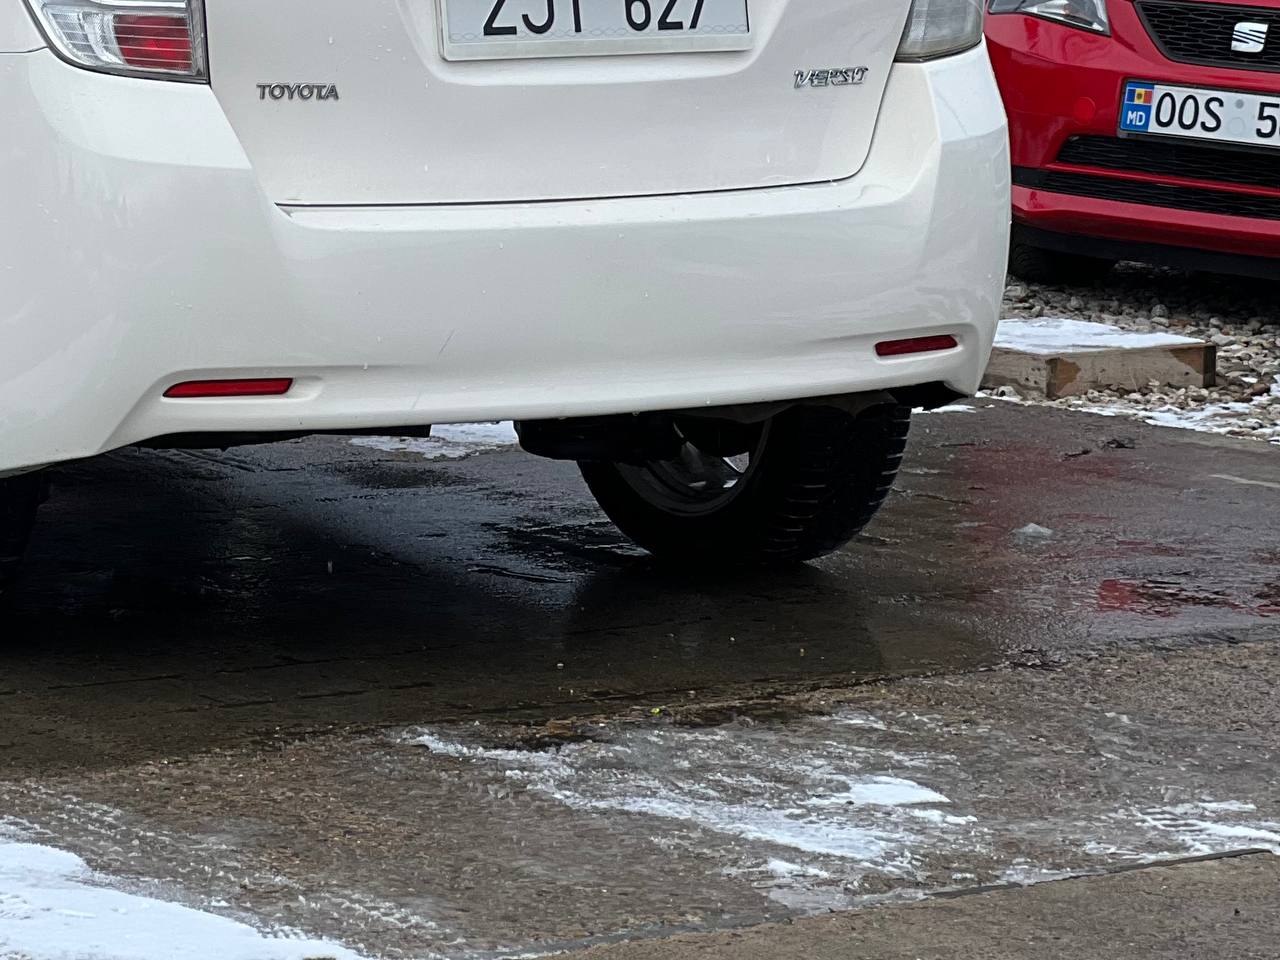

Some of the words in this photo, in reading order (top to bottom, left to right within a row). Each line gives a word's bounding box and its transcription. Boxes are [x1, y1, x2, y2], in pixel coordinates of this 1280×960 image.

[256, 82, 339, 100] TOYOTA
[1127, 110, 1146, 126] MD
[1256, 101, 1280, 138] 5
